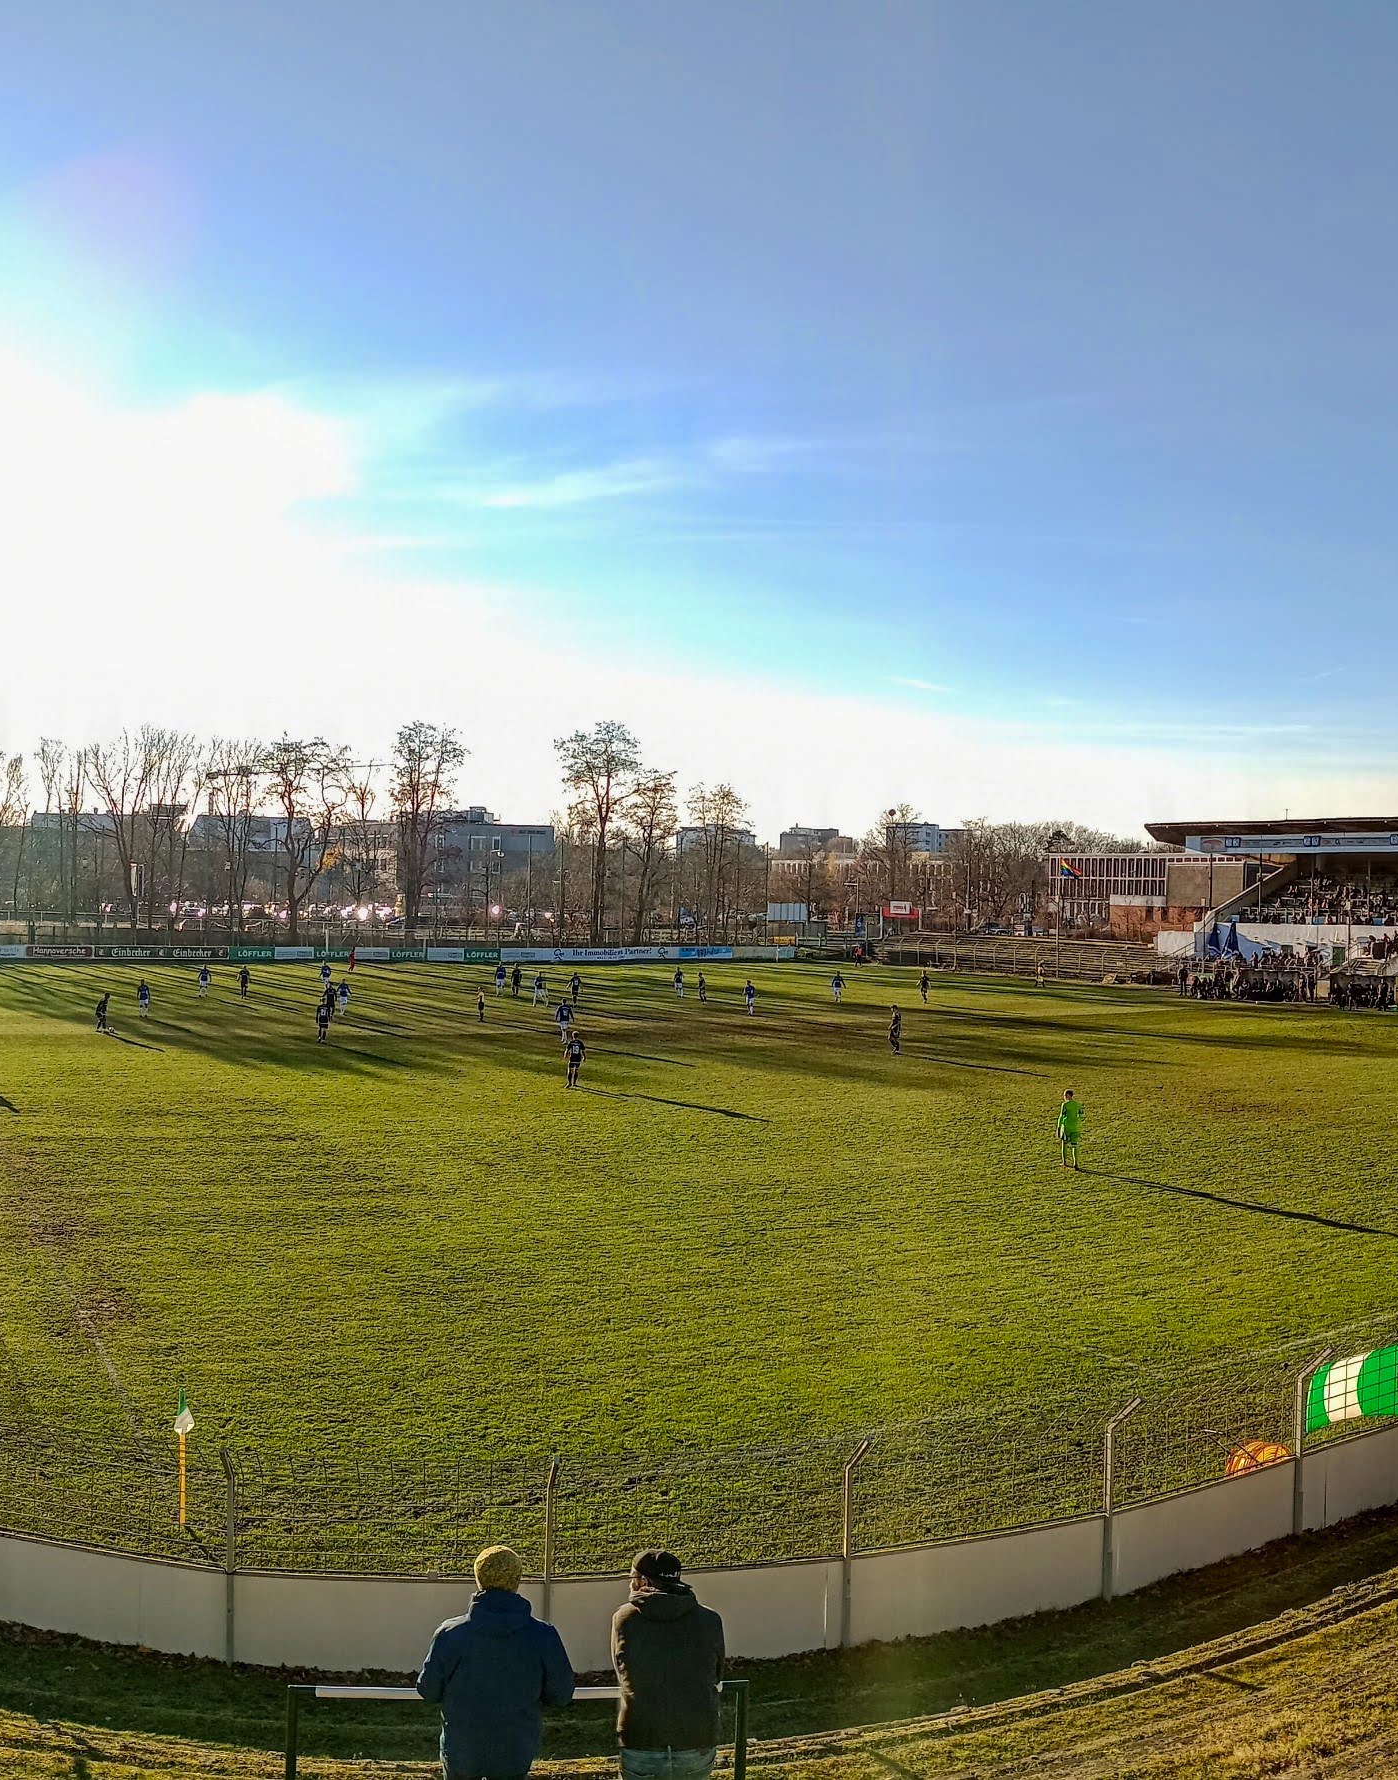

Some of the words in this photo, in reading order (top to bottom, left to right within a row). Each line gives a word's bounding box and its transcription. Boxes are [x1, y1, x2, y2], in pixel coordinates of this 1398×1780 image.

[33, 947, 86, 955] Hannoversche
[111, 948, 151, 957] Einbecker
[172, 948, 212, 957] Einbecker
[238, 948, 272, 958] LÖFFLER
[316, 949, 349, 958] LÖFFLER
[392, 950, 425, 958] LÖFFLER
[466, 949, 498, 958] LÖFFLER
[572, 949, 584, 957] Ihr
[584, 949, 623, 957] Immobilien
[625, 948, 652, 956] Partner!
